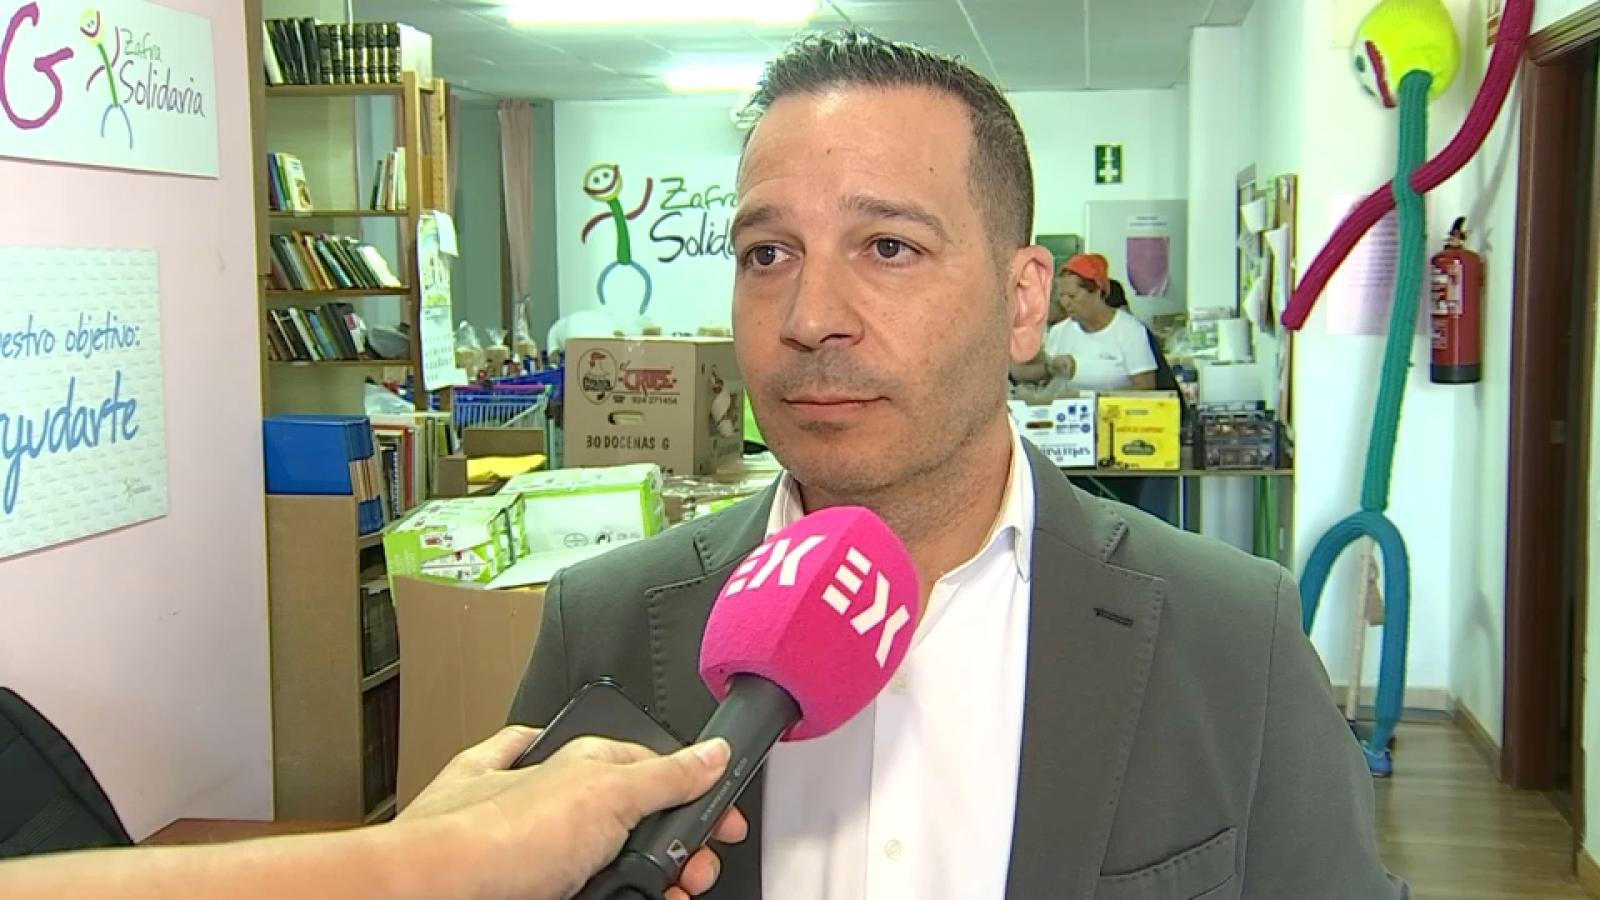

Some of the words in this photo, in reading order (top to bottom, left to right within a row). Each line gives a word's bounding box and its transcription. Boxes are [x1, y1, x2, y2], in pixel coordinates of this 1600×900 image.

[120, 27, 162, 62] Zafra
[119, 59, 205, 118] Solidaria
[0, 314, 56, 359] estro
[65, 311, 140, 359] objetivo:
[586, 434, 601, 449] 30
[603, 434, 656, 450] DOCENAS
